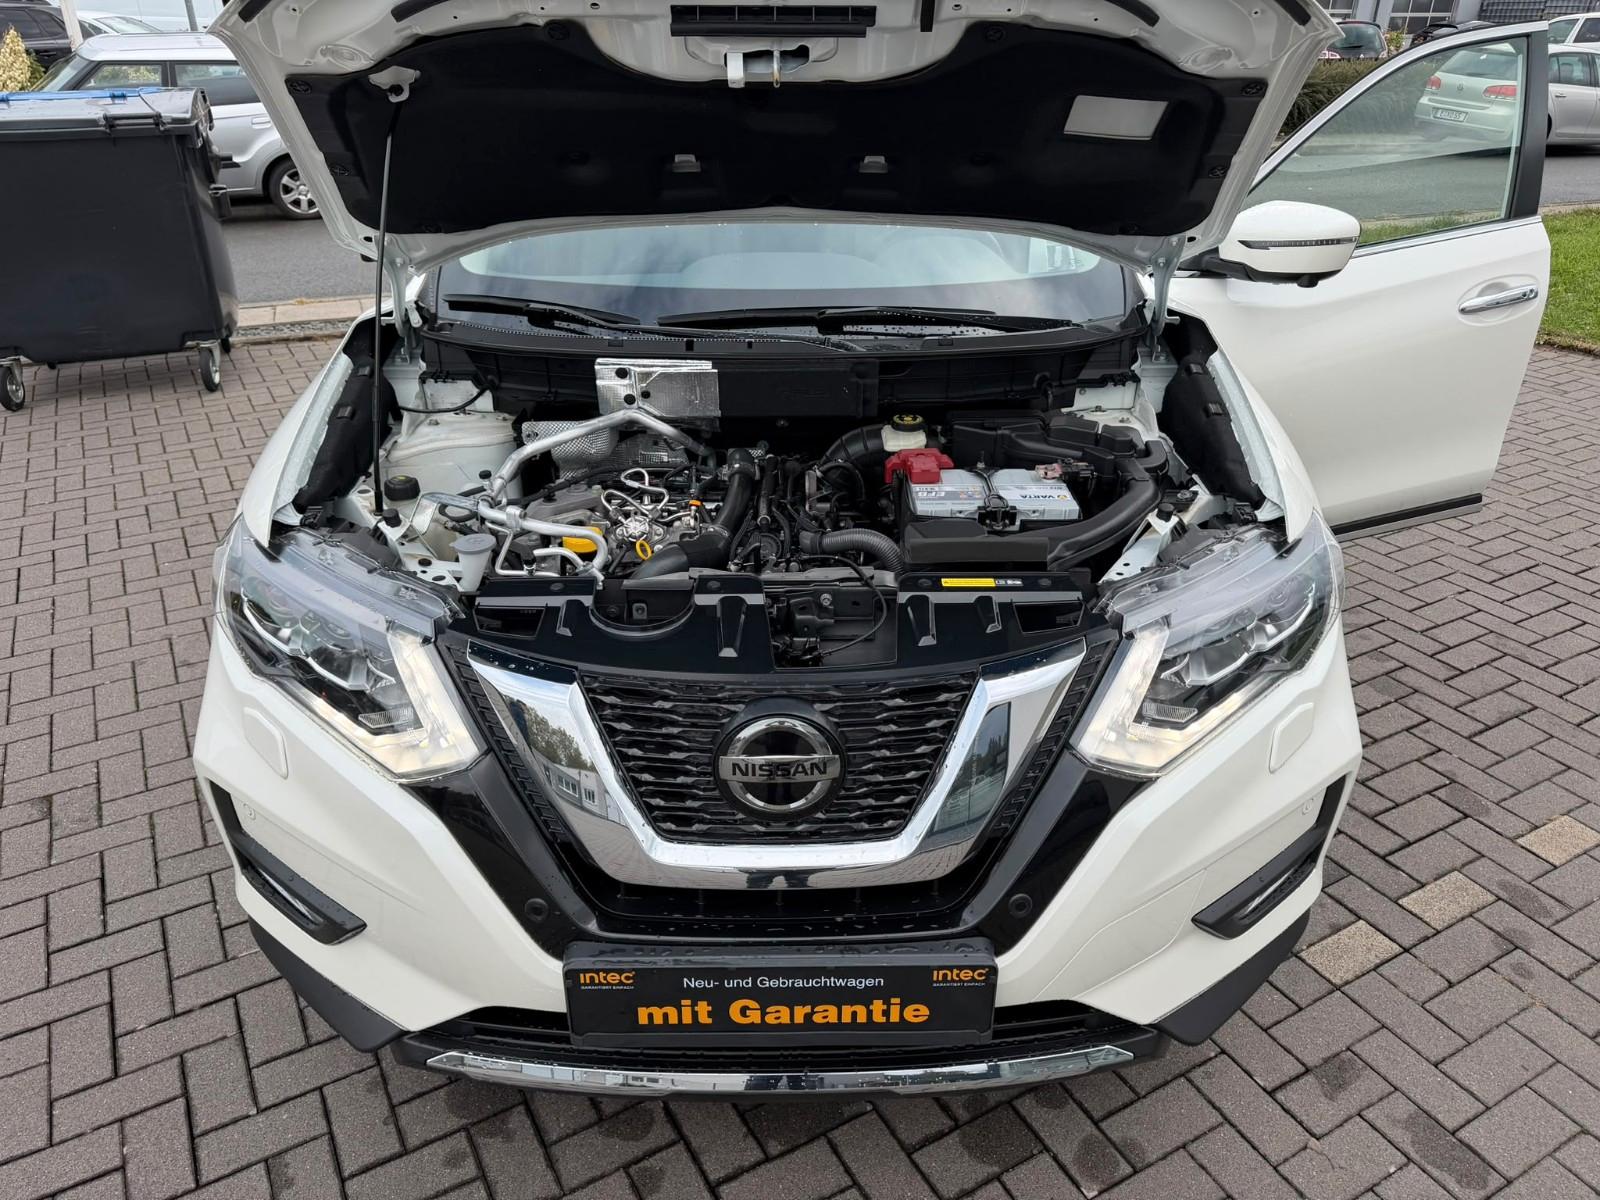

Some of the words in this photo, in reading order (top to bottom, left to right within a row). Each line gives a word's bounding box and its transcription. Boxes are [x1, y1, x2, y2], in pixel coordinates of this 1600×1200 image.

[731, 761, 828, 777] NISSAN
[579, 971, 634, 984] intec
[932, 968, 986, 981] intec
[683, 977, 720, 989] Neu-
[724, 976, 752, 988] und
[756, 975, 885, 990] Gebrauchtwagen
[637, 999, 713, 1025] mit
[728, 997, 931, 1025] Garantie
